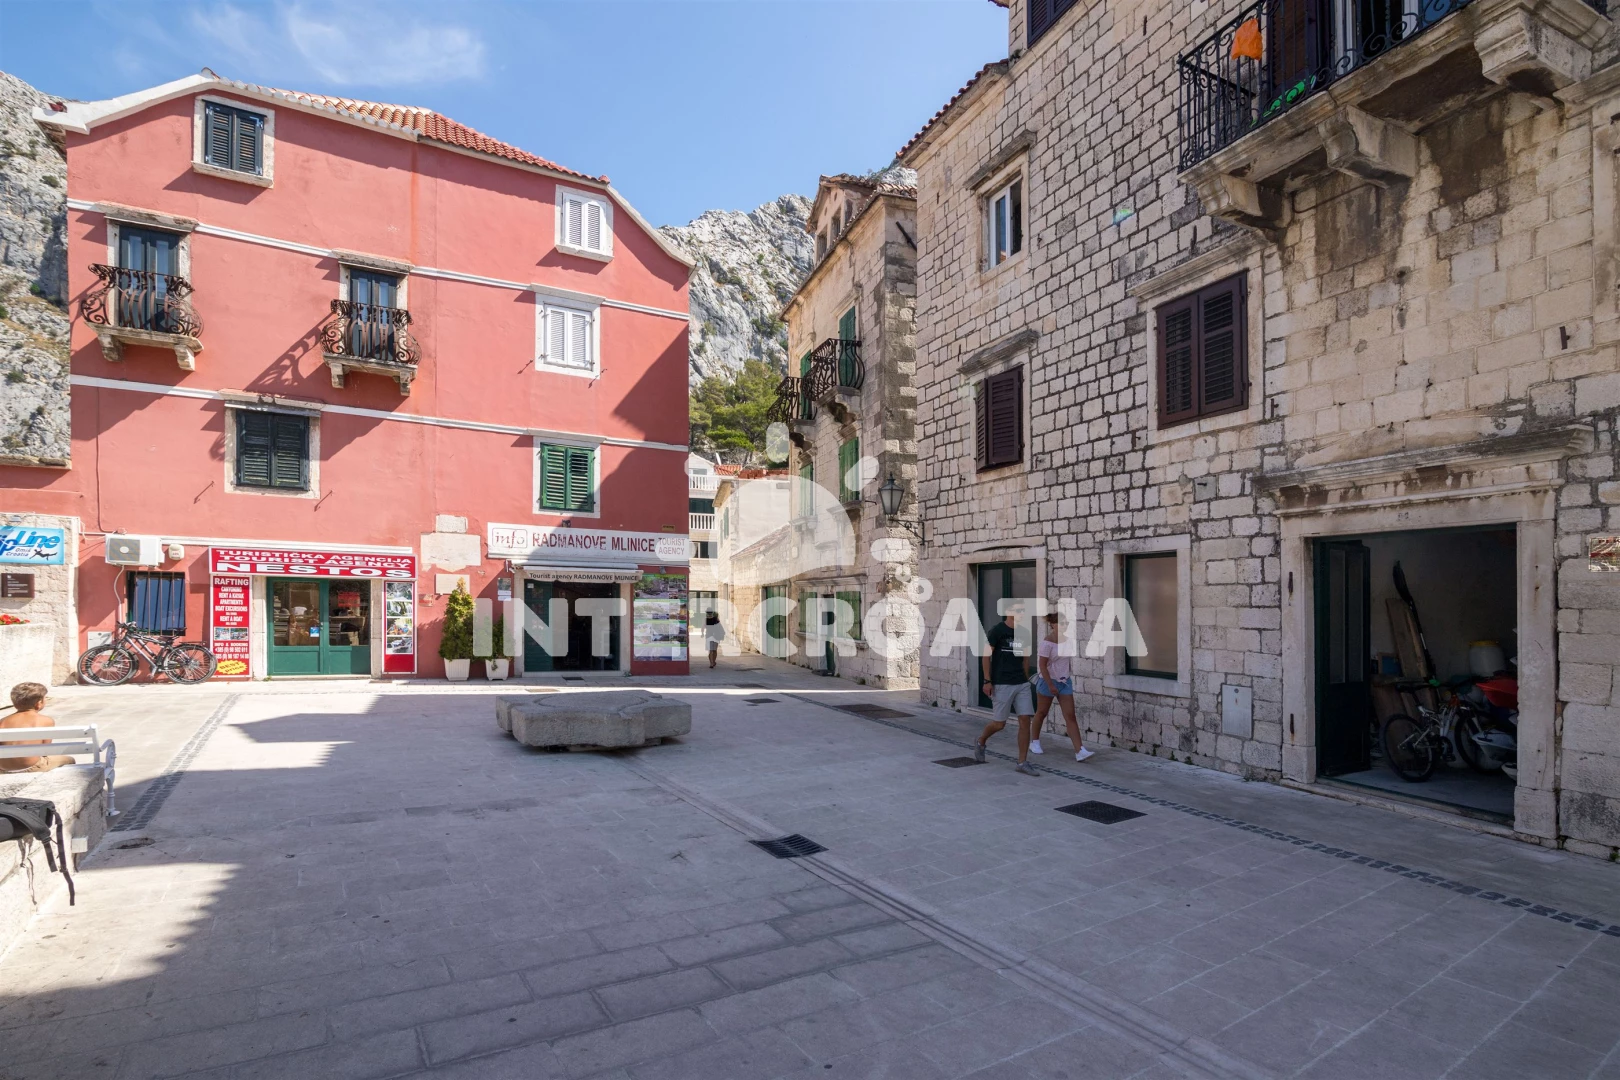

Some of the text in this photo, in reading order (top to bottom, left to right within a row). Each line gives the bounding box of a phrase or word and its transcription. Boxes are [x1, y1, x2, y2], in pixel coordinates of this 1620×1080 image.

[494, 530, 656, 552] info RADMANOVE MLINICE
[658, 538, 686, 546] TOURIST
[658, 547, 685, 555] AGENCY
[216, 549, 412, 564] TURISTIČKA AGENCIJA
[220, 555, 409, 569] TOURIST AGENCY
[216, 562, 412, 578] NESTOS
[214, 577, 249, 586] RAFTING
[573, 573, 613, 581] RADMANOVE
[219, 661, 240, 670] BEST
